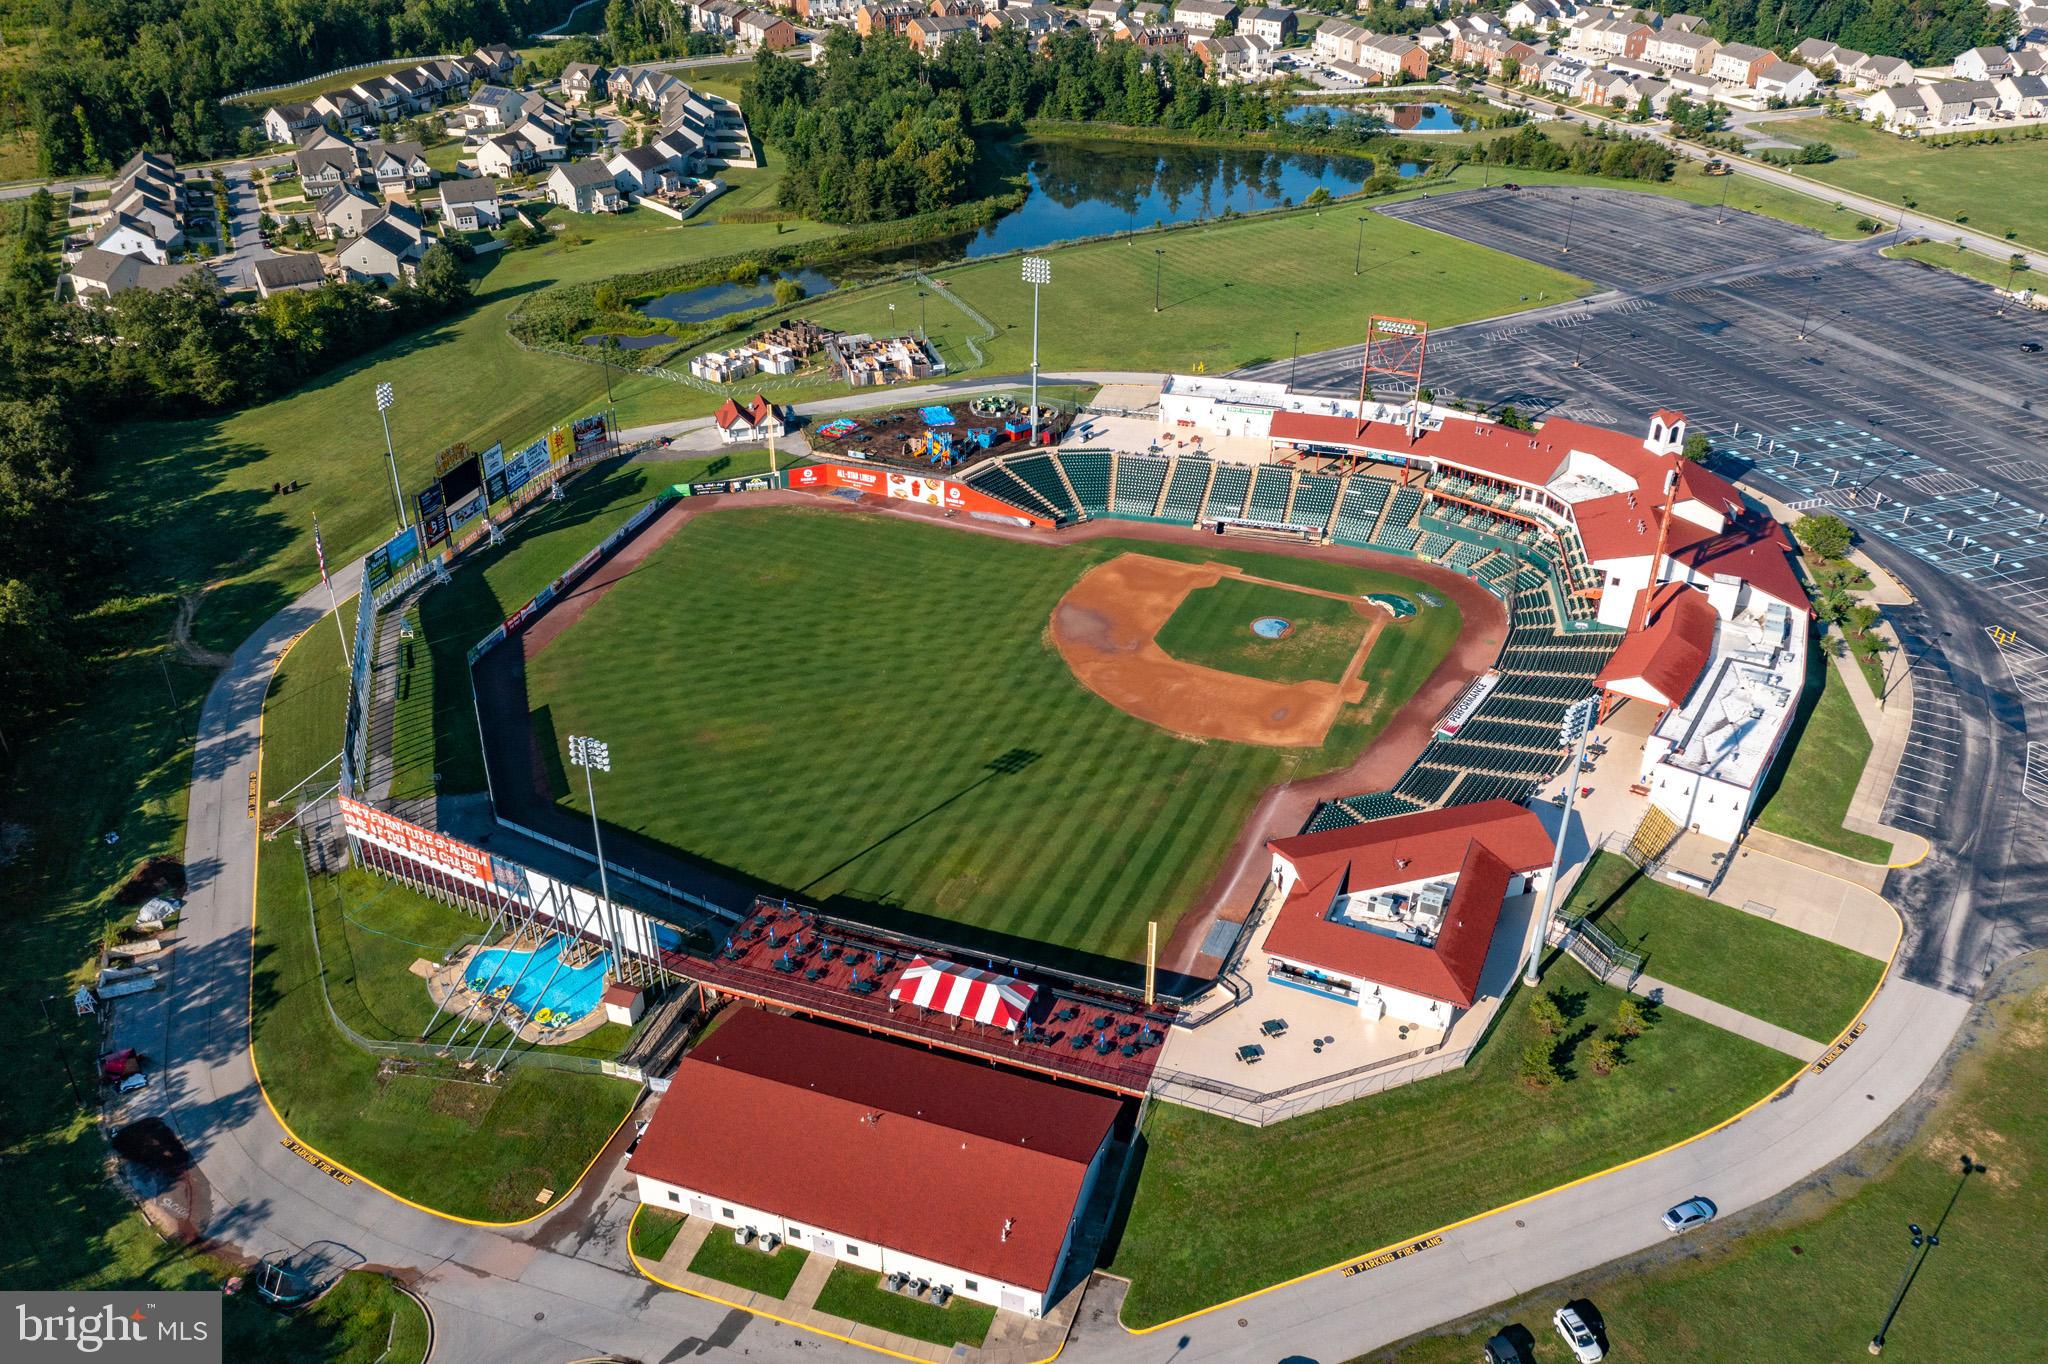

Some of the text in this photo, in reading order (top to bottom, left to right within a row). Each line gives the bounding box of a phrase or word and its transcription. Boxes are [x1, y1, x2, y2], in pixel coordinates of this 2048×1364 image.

[1449, 683, 1487, 722] PERFORMANCE
[370, 812, 433, 844] FURNITURE
[434, 838, 488, 867] STADIUM
[370, 823, 384, 837] OF
[384, 829, 406, 846] THE
[409, 839, 437, 858] BLUE
[439, 851, 477, 874] CRABS
[1819, 1046, 1845, 1066] PARKING
[1841, 1036, 1857, 1047] FIRE
[1851, 1021, 1868, 1036] LANE
[281, 1136, 354, 1186] NO PARKING FIRE LANE
[1342, 1236, 1442, 1277] NO PARKING FIRE LANE
